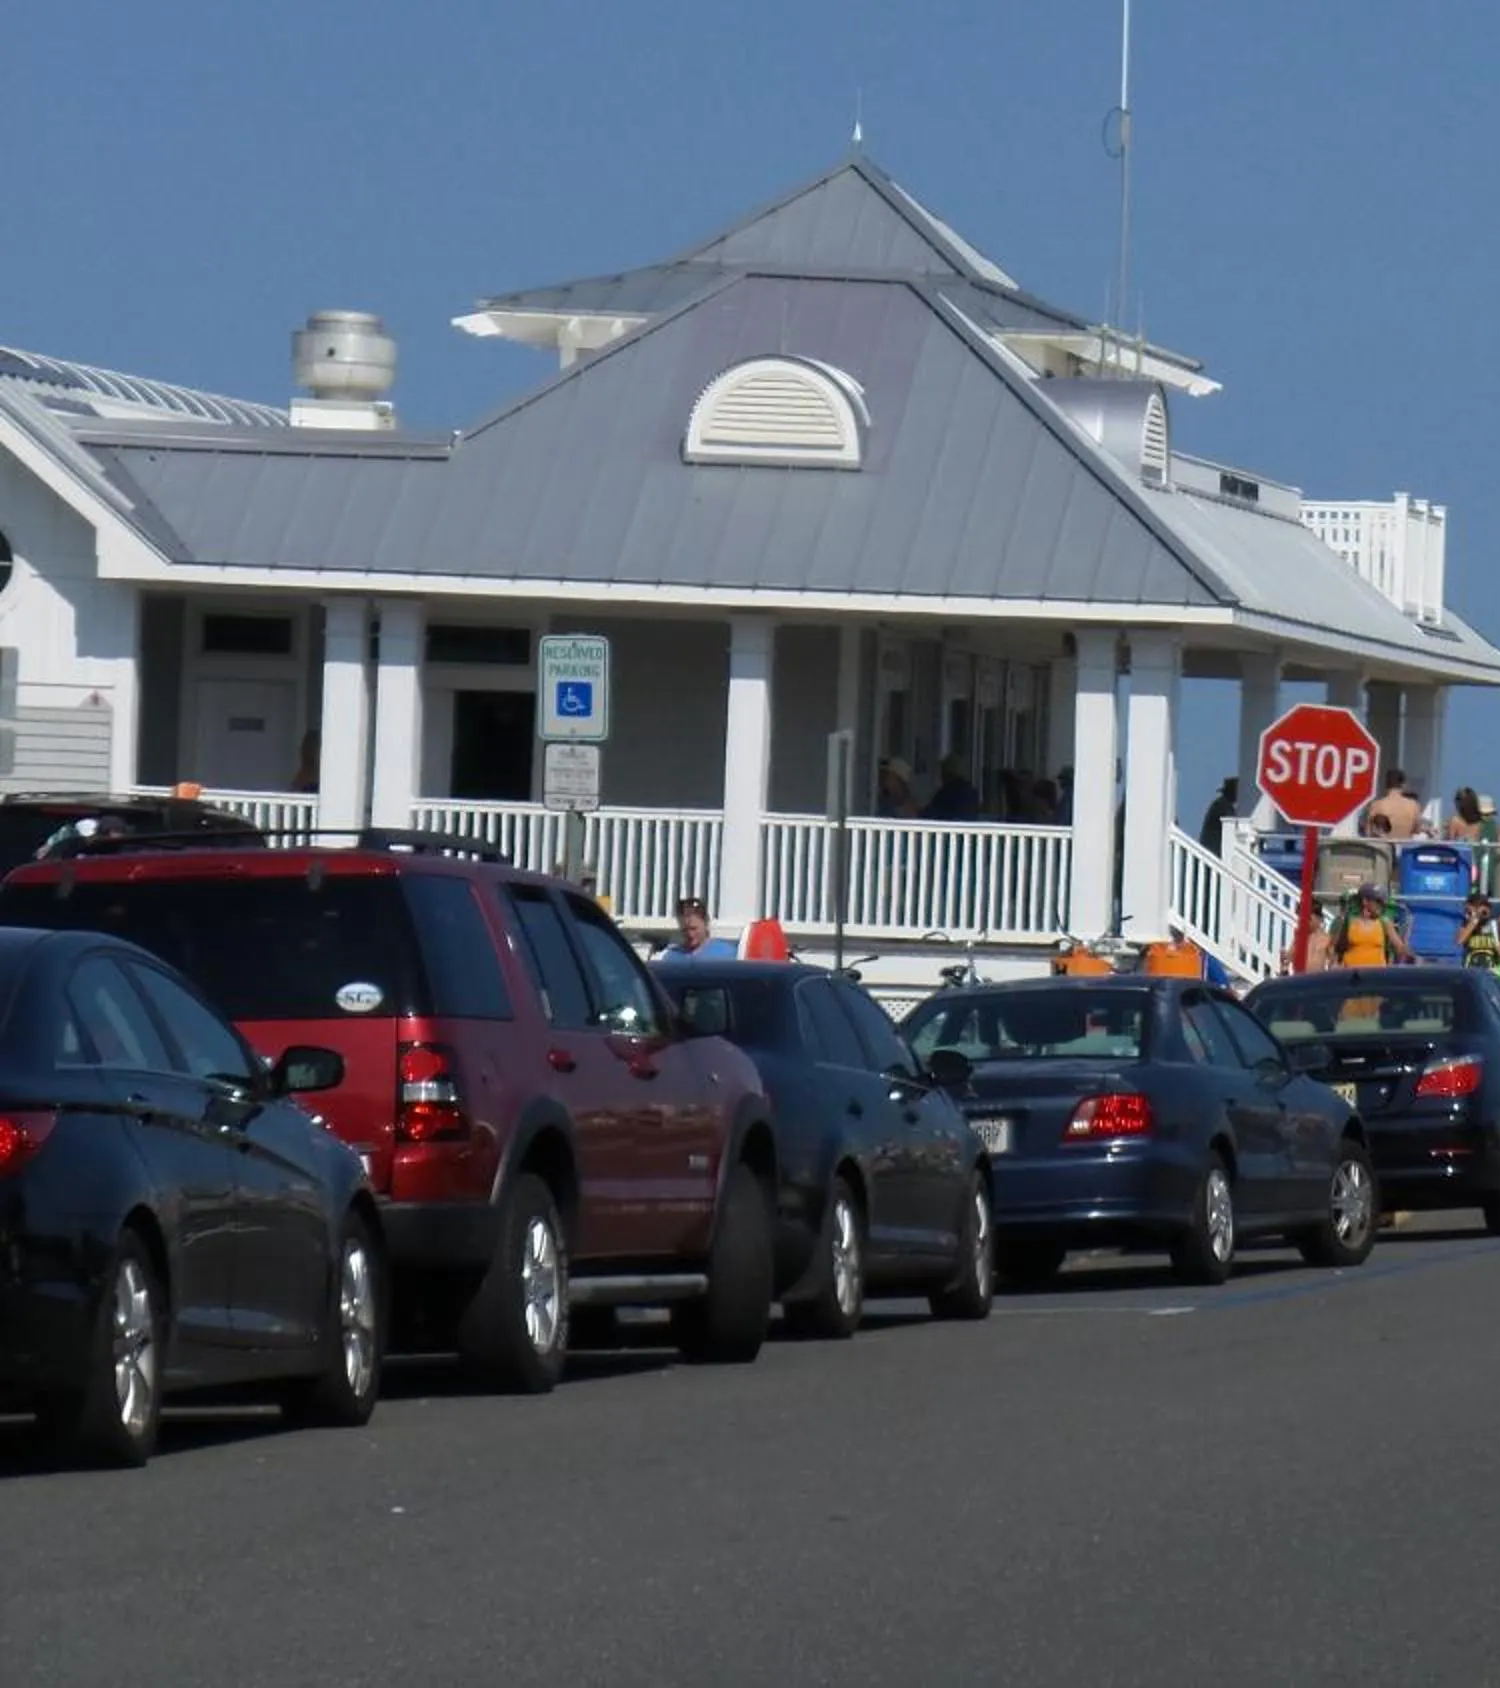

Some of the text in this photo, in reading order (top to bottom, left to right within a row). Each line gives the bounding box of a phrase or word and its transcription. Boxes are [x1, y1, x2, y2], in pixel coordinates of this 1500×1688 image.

[544, 646, 602, 660] RESERVED
[548, 662, 602, 677] PARKING
[1266, 739, 1370, 790] STOP
